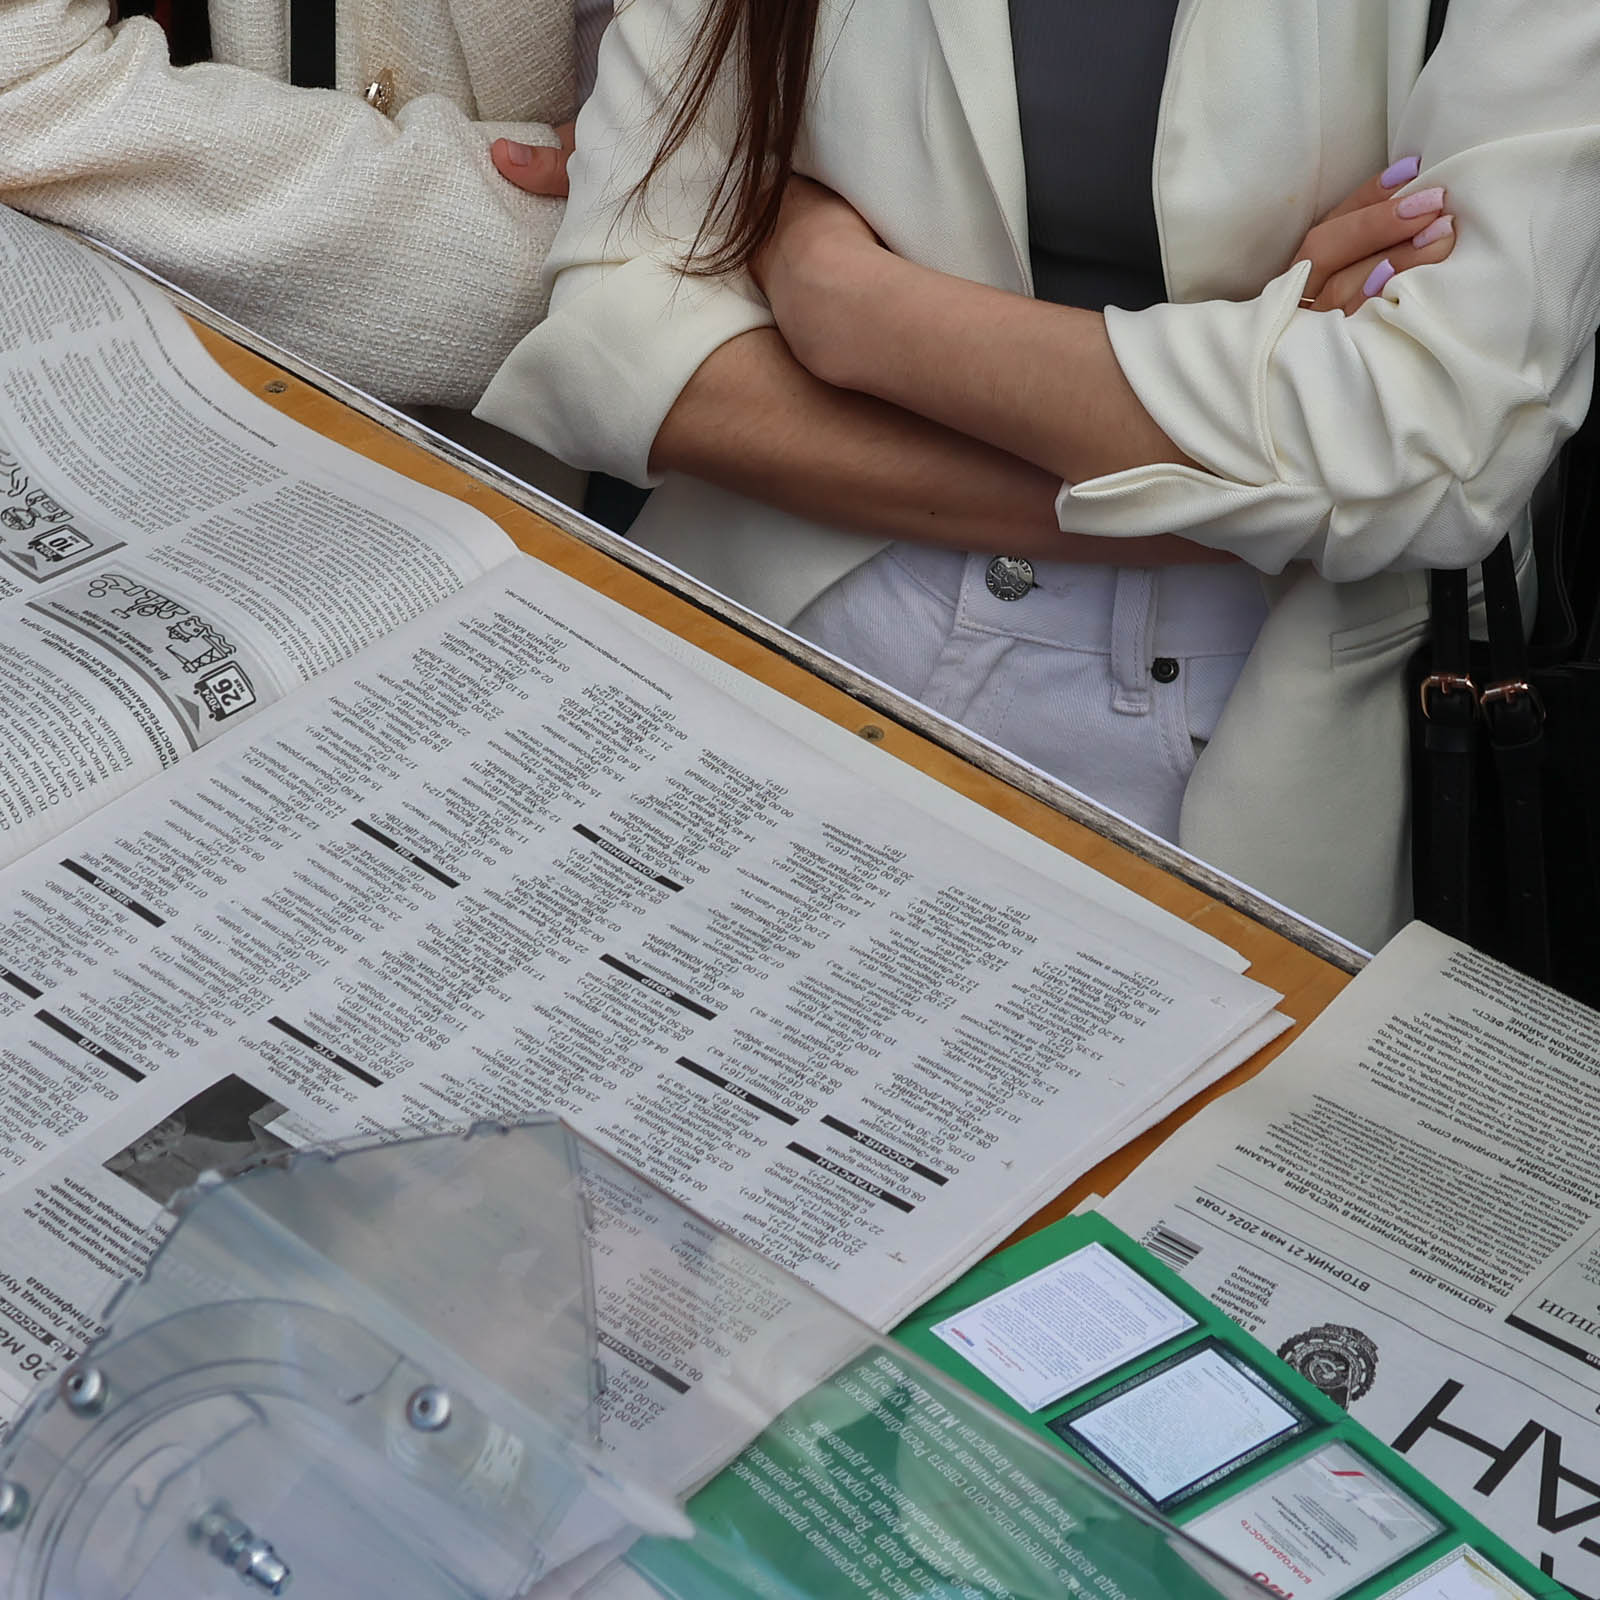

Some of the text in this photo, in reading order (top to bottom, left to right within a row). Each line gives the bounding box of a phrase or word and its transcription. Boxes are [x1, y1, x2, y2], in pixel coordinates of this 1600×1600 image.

[212, 678, 240, 706] 26
[391, 841, 417, 863] ТВЦ
[592, 835, 662, 880] ДОМАШНИЙ
[90, 874, 134, 908] ЗВЕЗДА
[639, 974, 676, 999] ЭФИР
[76, 1034, 103, 1057] НТВ
[310, 1040, 338, 1062] СТС
[723, 1079, 750, 1099] ТНВ
[1417, 1120, 1452, 1138] СПРОС
[852, 1129, 917, 1169] РОССИЯ-К
[1235, 1145, 1277, 1169] КАЗАНИ
[1452, 1136, 1522, 1172] РЕКОРДНЫЙ
[814, 1154, 885, 1198] ТАТАРСТАН
[1284, 1180, 1309, 1194] ДНЯ
[1286, 1170, 1344, 1203] СОСТОЯТСЯ
[1516, 1157, 1588, 1193] НОВОСТРОЙКИ
[1309, 1192, 1339, 1212] ЧЕСТЬ
[1346, 1201, 1428, 1247] ЖУРНАЛИСТИКИ
[1350, 1214, 1428, 1256] МЕРОПРИЯТИЯ
[1196, 1196, 1370, 1292] ВТОРНИК 21 мая 2024 года
[1237, 1265, 1278, 1289] Знамени
[1428, 1250, 1510, 1297] ПРАЗДНИЧНЫЕ
[1430, 1244, 1514, 1291] ТАТАРСТАНСКОЙ
[1217, 1286, 1258, 1310] орденом
[1224, 1279, 1269, 1307] Трудового
[1231, 1272, 1273, 1297] Красного
[1409, 1263, 1496, 1314] картина дня
[20, 1290, 67, 1327] Леонид
[1211, 1293, 1266, 1325] награждена
[1239, 1518, 1314, 1586] БЛАГОДАРНОСТЬ
